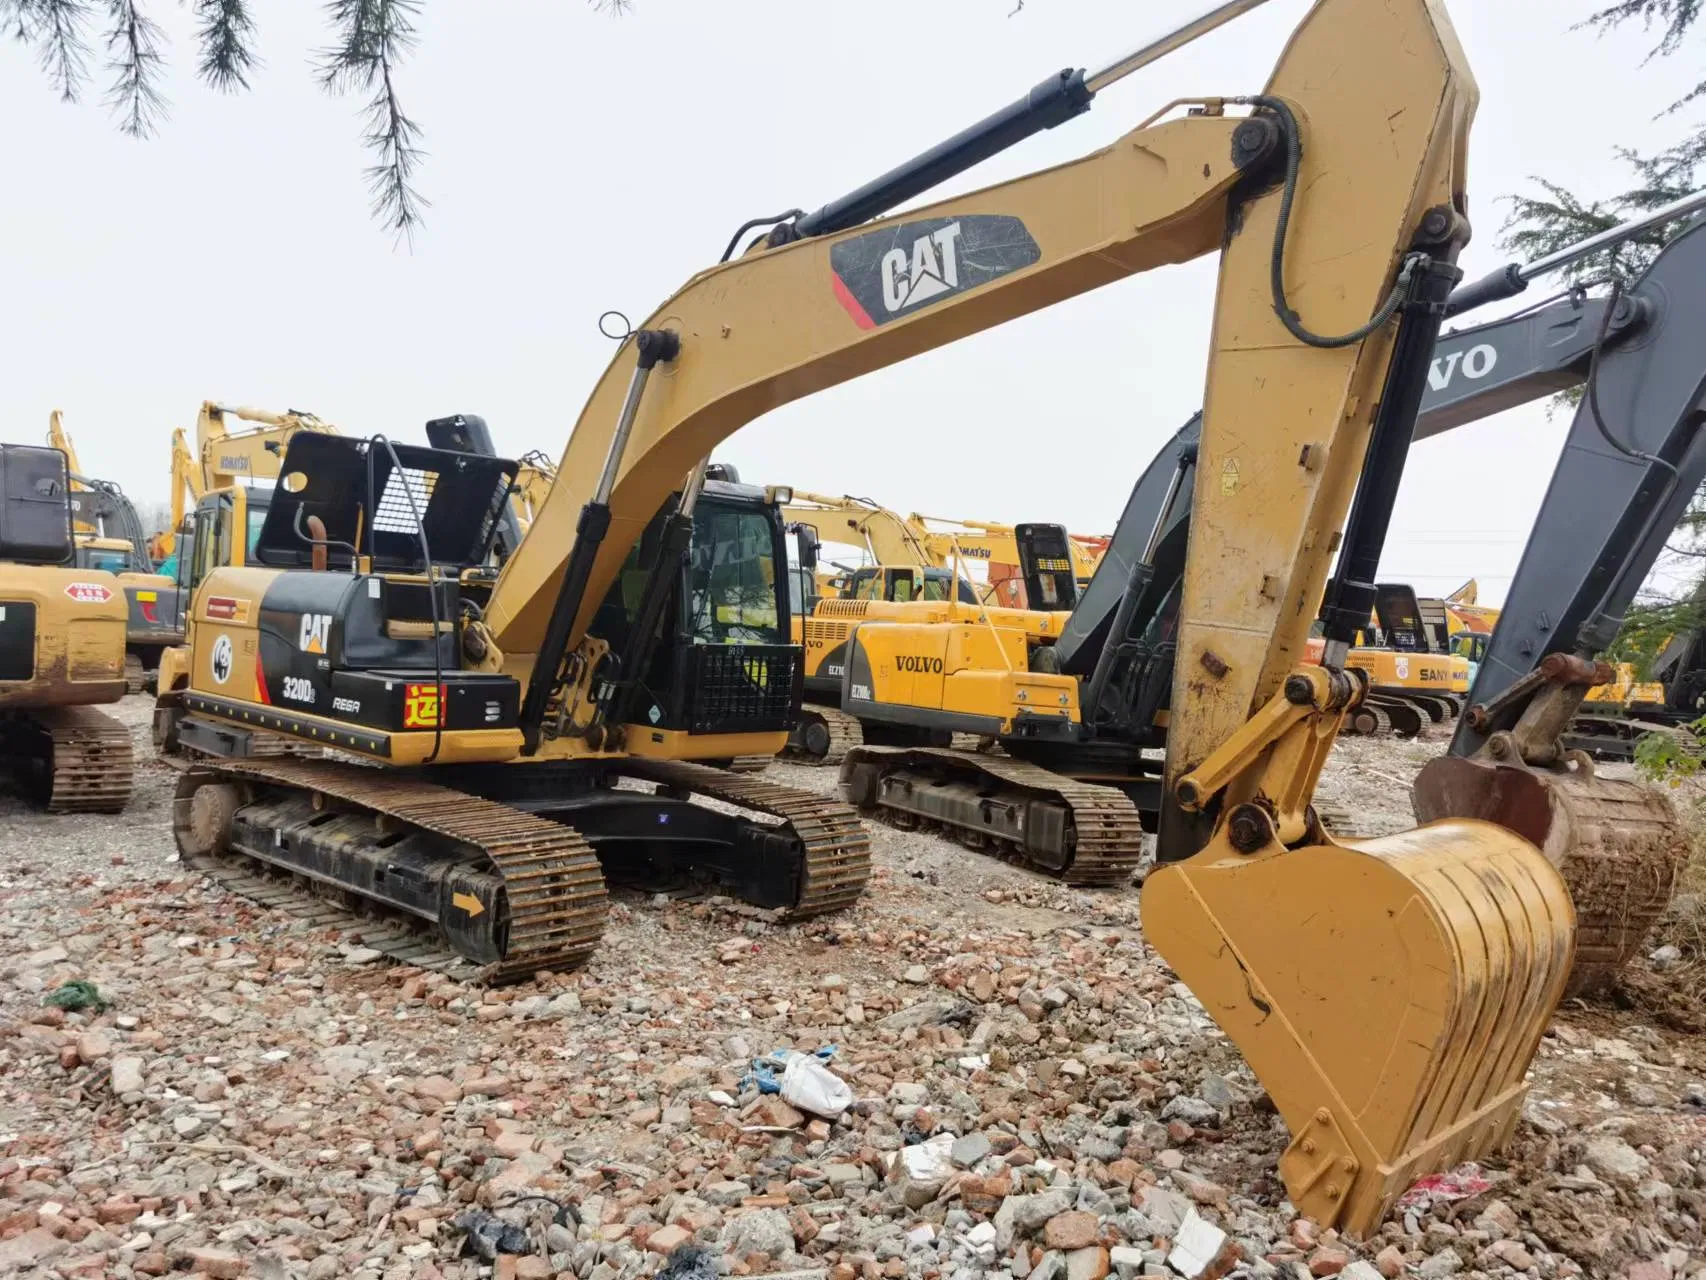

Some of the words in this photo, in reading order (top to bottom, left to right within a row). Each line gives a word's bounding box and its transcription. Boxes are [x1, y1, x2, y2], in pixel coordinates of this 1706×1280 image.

[881, 221, 961, 312] CAT
[300, 613, 333, 654] CAT
[895, 655, 943, 674] VOLVO
[1419, 668, 1448, 681] SANY
[404, 685, 446, 726] 运
